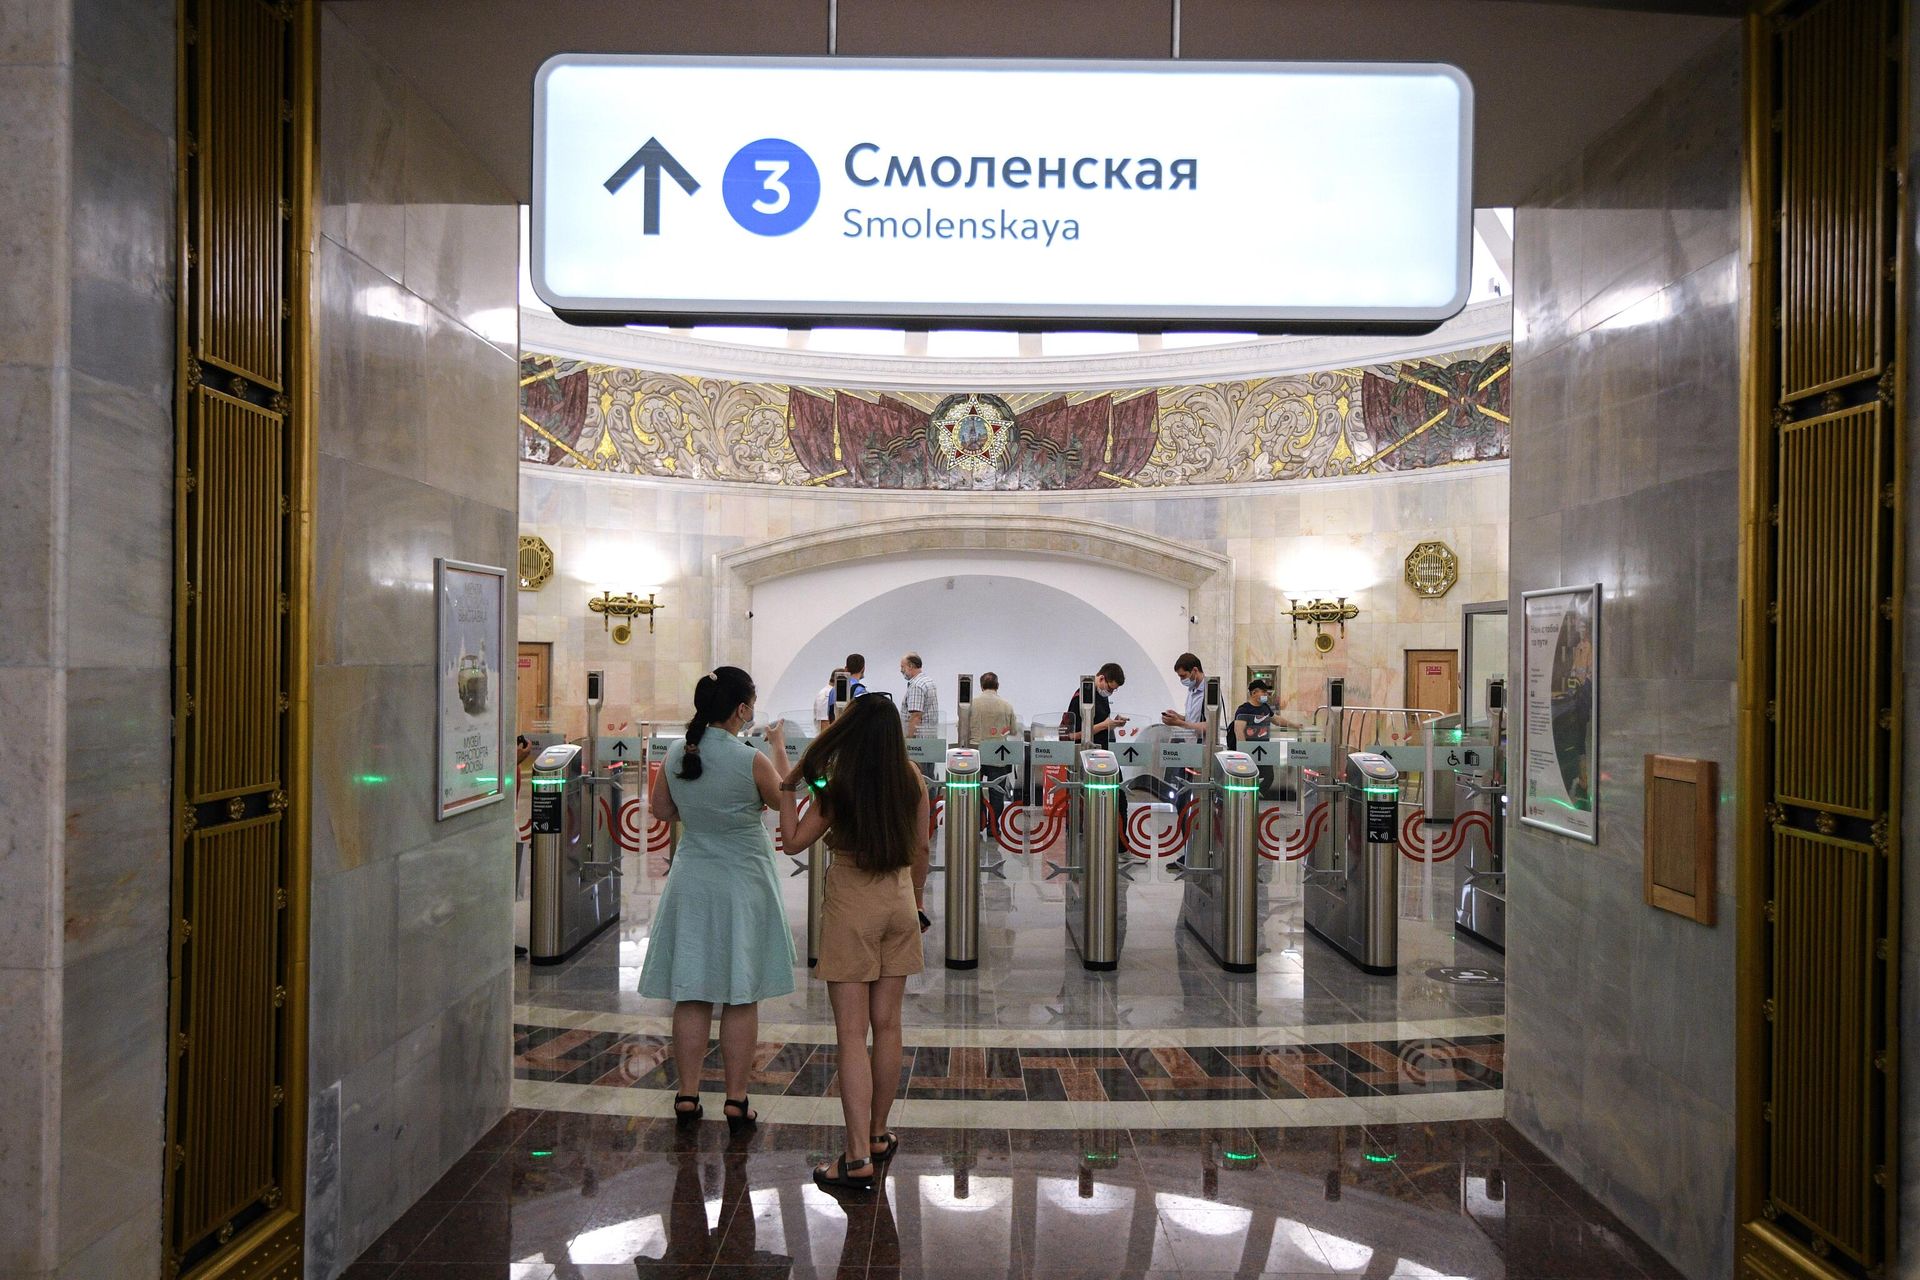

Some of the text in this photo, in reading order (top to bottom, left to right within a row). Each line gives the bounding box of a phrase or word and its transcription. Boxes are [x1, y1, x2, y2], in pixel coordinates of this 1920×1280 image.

[752, 143, 1198, 214] 3 Смоленская
[844, 209, 1079, 248] Smolenskaya
